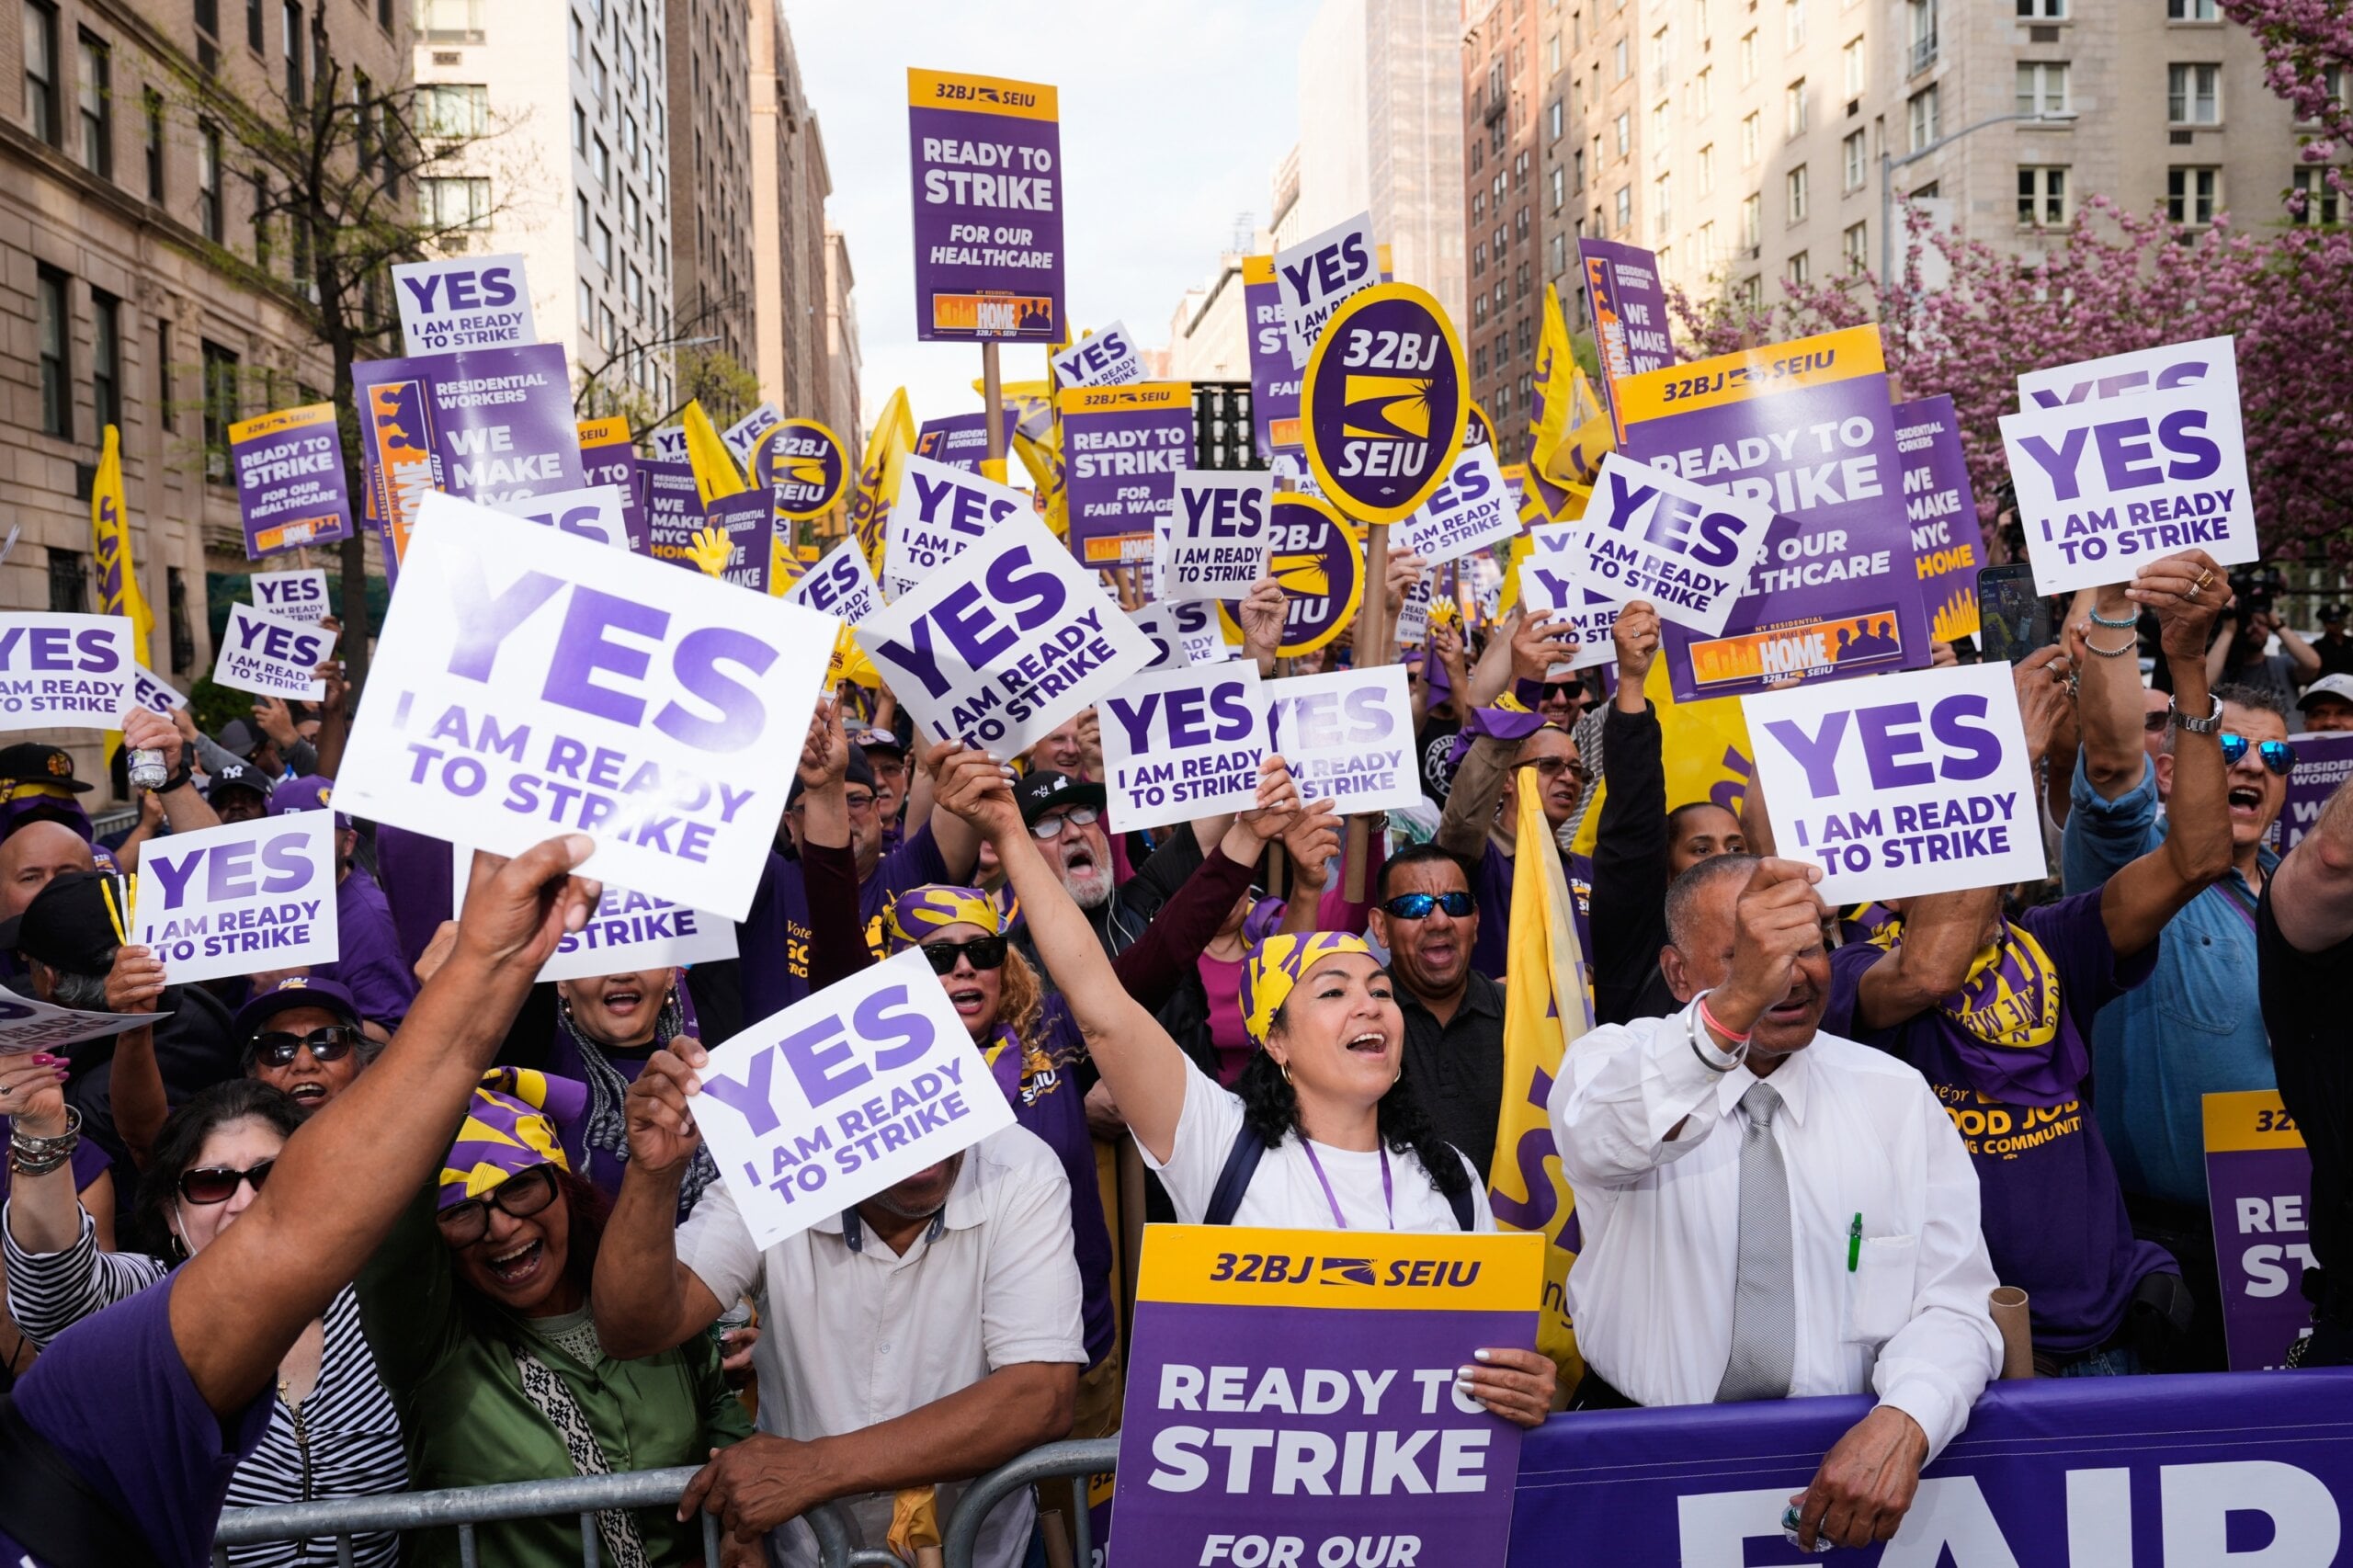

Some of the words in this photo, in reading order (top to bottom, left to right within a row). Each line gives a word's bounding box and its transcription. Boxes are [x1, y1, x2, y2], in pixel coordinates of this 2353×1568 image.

[936, 84, 975, 101] 32BJ
[1003, 92, 1036, 108] SEIU
[924, 138, 1013, 169] READY
[1019, 148, 1051, 172] TO
[926, 170, 1052, 211] STRIKE
[950, 225, 989, 243] FOR
[995, 228, 1032, 245] OUR
[930, 247, 1052, 268] HEALTHCARE
[1282, 232, 1369, 307] YES
[1615, 264, 1654, 280] RESIDENTIAL
[403, 267, 517, 314] YES
[1617, 276, 1649, 290] WORKERS
[413, 324, 418, 335] I
[425, 320, 454, 334] AM
[460, 312, 524, 332] READY
[977, 303, 1015, 329] HOME
[1305, 306, 1327, 330] AM
[1624, 303, 1650, 325] WE
[422, 335, 449, 349] TO
[454, 325, 520, 346] STRIKE
[1343, 329, 1439, 371] 32BJ
[1629, 329, 1667, 354] MAKE
[1059, 332, 1126, 381] YES
[1101, 356, 1137, 381] READY
[436, 374, 547, 396] RESIDENTIAL
[1663, 374, 1724, 403] 32BJ
[1773, 349, 1836, 379] SEIU
[438, 390, 527, 409] WORKERS
[1084, 393, 1117, 406] 32BJ
[1141, 392, 1170, 403] SEIU
[447, 426, 514, 456] WE
[580, 427, 608, 441] SEIU
[728, 411, 779, 449] YES
[1074, 430, 1151, 450] READY
[1154, 427, 1185, 445] TO
[241, 441, 300, 469] READY
[303, 437, 331, 453] TO
[771, 437, 828, 457] 32BJ
[1338, 440, 1427, 477] SEIU
[1649, 430, 1799, 480] READY
[1811, 415, 1874, 453] TO
[2016, 409, 2222, 502] YES
[243, 451, 335, 489] STRIKE
[431, 454, 444, 483] SEIU
[453, 453, 563, 489] MAKE
[599, 464, 629, 483] TO
[1075, 449, 1187, 478] STRIKE
[261, 488, 288, 504] FOR
[290, 482, 320, 495] OUR
[374, 463, 389, 520] RESIDENTIAL
[654, 482, 695, 491] WORKERS
[774, 483, 825, 502] SEIU
[1117, 486, 1151, 500] FOR
[251, 490, 337, 519] HEALTHCARE
[654, 498, 685, 513] WE
[1084, 504, 1122, 517] FAIR
[1181, 487, 1262, 538] YES
[1608, 472, 1747, 567] YES
[1906, 489, 1961, 523] MAKE
[2040, 519, 2052, 541] I
[2063, 505, 2118, 539] AM
[2128, 488, 2235, 528] READY
[383, 525, 392, 537] NY
[651, 529, 688, 543] NYC
[652, 514, 704, 529] MAKE
[1413, 523, 1439, 552] AM
[1445, 497, 1502, 536] READY
[1439, 514, 1503, 551] STRIKE
[1911, 521, 1950, 551] NYC
[915, 533, 949, 552] AM
[1175, 549, 1180, 563] I
[1185, 548, 1210, 563] AM
[1214, 547, 1262, 562] READY
[1778, 529, 1848, 561] OUR
[2058, 540, 2109, 564] TO
[2116, 517, 2231, 557] STRIKE
[908, 549, 936, 566] TO
[1178, 567, 1199, 582] TO
[1203, 565, 1256, 581] STRIKE
[1585, 532, 1595, 550] I
[1597, 538, 1638, 567] AM
[1643, 555, 1731, 597] READY
[1915, 544, 1974, 580] HOME
[257, 578, 320, 603] YES
[1589, 553, 1620, 581] TO
[1625, 569, 1712, 613] STRIKE
[289, 605, 324, 614] READY
[875, 545, 1066, 699] YES
[1770, 617, 1823, 630] RESIDENTIAL
[237, 615, 322, 667] YES
[436, 542, 781, 755] YES
[1780, 630, 1799, 638] MAKE
[1801, 628, 1813, 636] NYC
[0, 628, 119, 673] YES
[228, 653, 232, 662] I
[236, 656, 260, 669] AM
[1759, 632, 1829, 675] HOME
[231, 665, 250, 678] TO
[255, 673, 309, 691] STRIKE
[951, 686, 1002, 733] AM
[997, 607, 1104, 695] READY
[1807, 665, 1833, 676] SEIU
[42, 680, 124, 697] READY
[961, 718, 1006, 750] TO
[1006, 637, 1117, 723] STRIKE
[31, 697, 117, 713] STRIKE
[1107, 681, 1254, 756] YES
[392, 690, 415, 730] I
[428, 704, 531, 765] AM
[545, 735, 756, 824] READY
[1763, 694, 2002, 799] YES
[406, 743, 487, 798] TO
[1119, 770, 1125, 789] I
[1133, 763, 1175, 787] AM
[1182, 747, 1263, 779] READY
[1312, 750, 1403, 778] READY
[1129, 789, 1165, 809] TO
[1172, 771, 1257, 802] STRIKE
[1302, 772, 1395, 799] STRIKE
[1795, 820, 1810, 846] I
[1822, 809, 1883, 844] AM
[1893, 791, 2017, 835] READY
[1816, 845, 1871, 875] TO
[1882, 825, 2011, 868] STRIKE
[149, 833, 314, 911] YES
[145, 925, 153, 943] I
[161, 915, 208, 940] AM
[219, 900, 321, 932] READY
[788, 919, 812, 938] Vote
[154, 940, 195, 963] TO
[204, 925, 311, 957] STRIKE
[700, 983, 936, 1139] YES
[743, 1161, 761, 1187] I
[770, 1125, 834, 1176] AM
[836, 1057, 964, 1142] READY
[769, 1164, 828, 1206] TO
[835, 1090, 971, 1176] STRIKE
[1211, 1254, 1314, 1285] 32BJ
[1384, 1260, 1482, 1287] SEIU
[1157, 1364, 1399, 1415] READY
[1147, 1426, 1492, 1495] STRIKE
[1199, 1534, 1304, 1568] FOR
[1317, 1534, 1422, 1568] OUR
